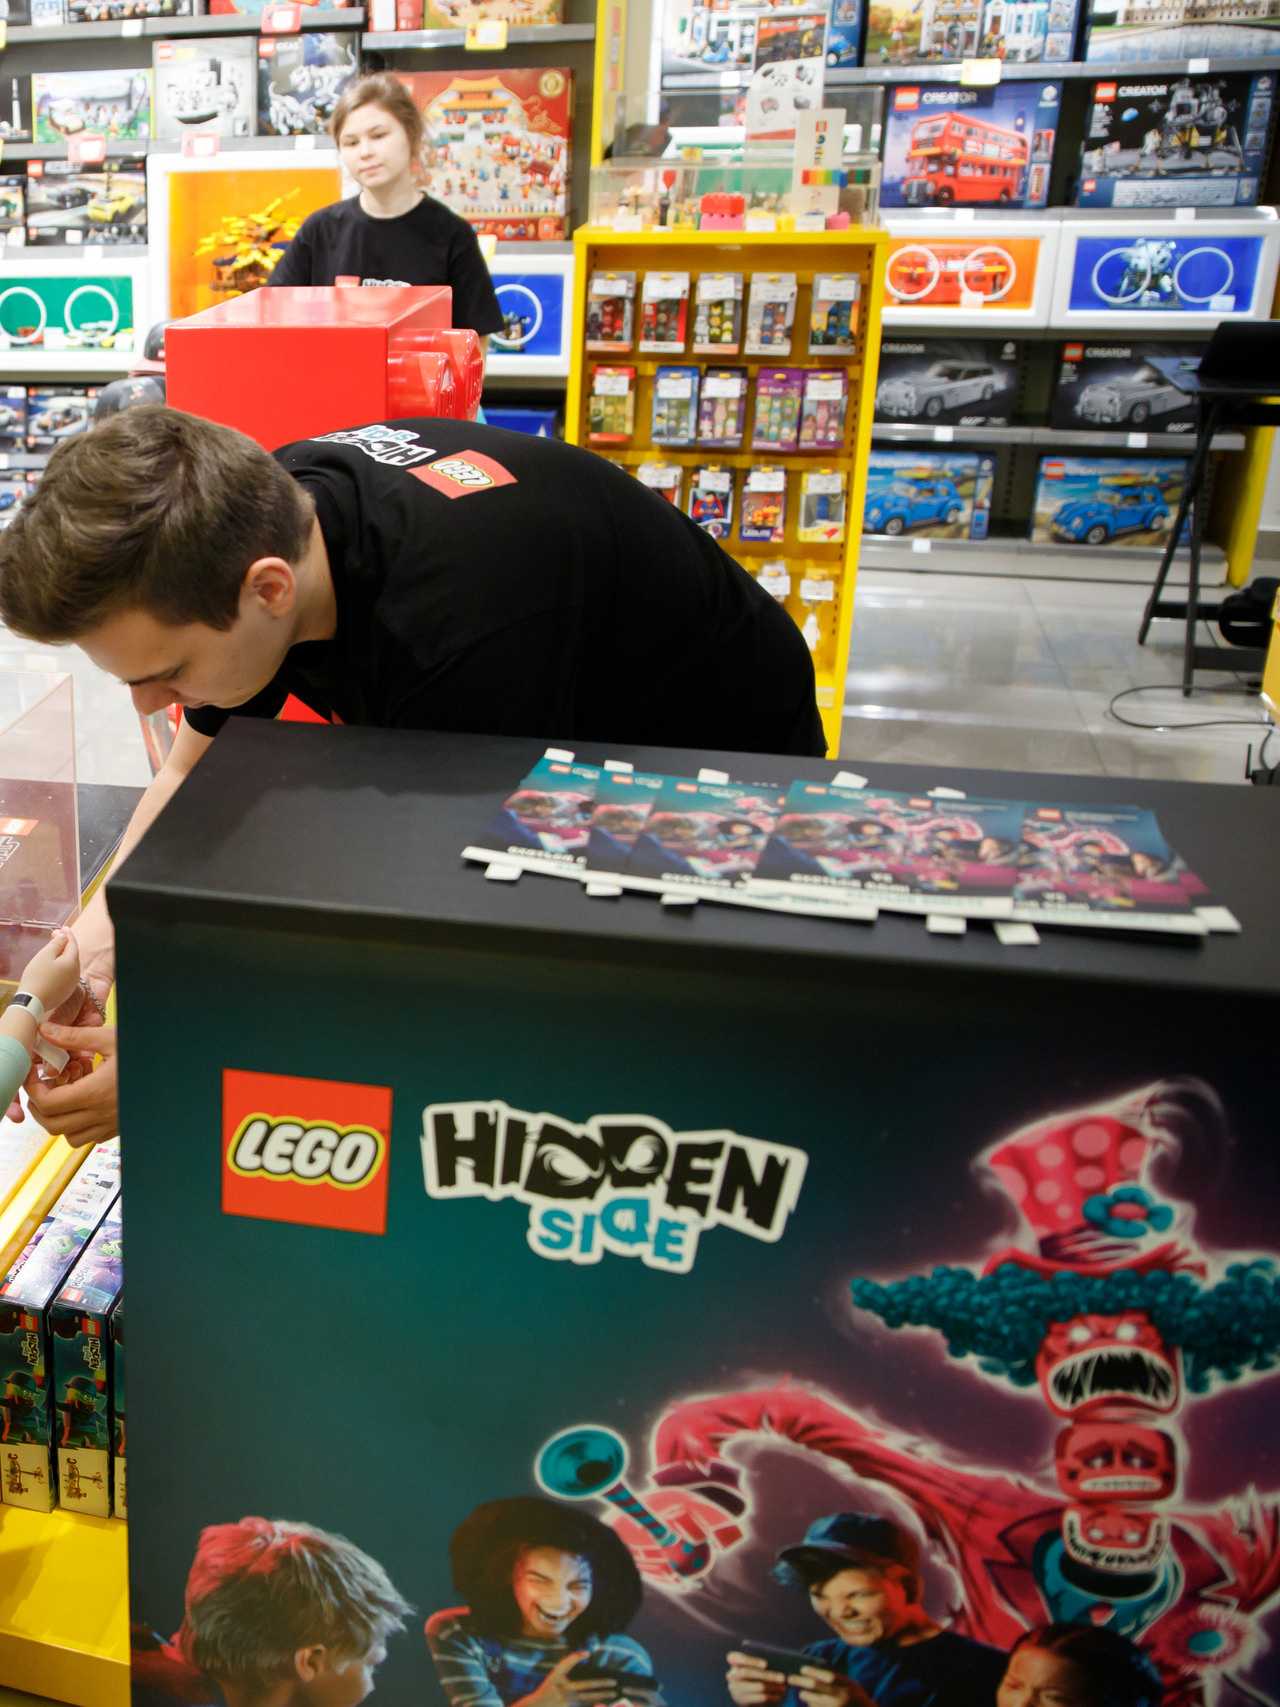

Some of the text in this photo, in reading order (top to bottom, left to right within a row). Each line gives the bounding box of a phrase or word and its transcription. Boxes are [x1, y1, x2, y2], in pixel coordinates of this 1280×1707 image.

[922, 91, 978, 104] CREATOR
[1117, 85, 1168, 97] CREATOR
[1084, 347, 1132, 358] CREATOR
[429, 459, 494, 487] LEGO
[228, 1103, 804, 1239] LEGO HIDDEN
[531, 1196, 692, 1268] SIDE
[26, 1333, 39, 1365] HIDDEN
[88, 1338, 101, 1370] HIDDEN
